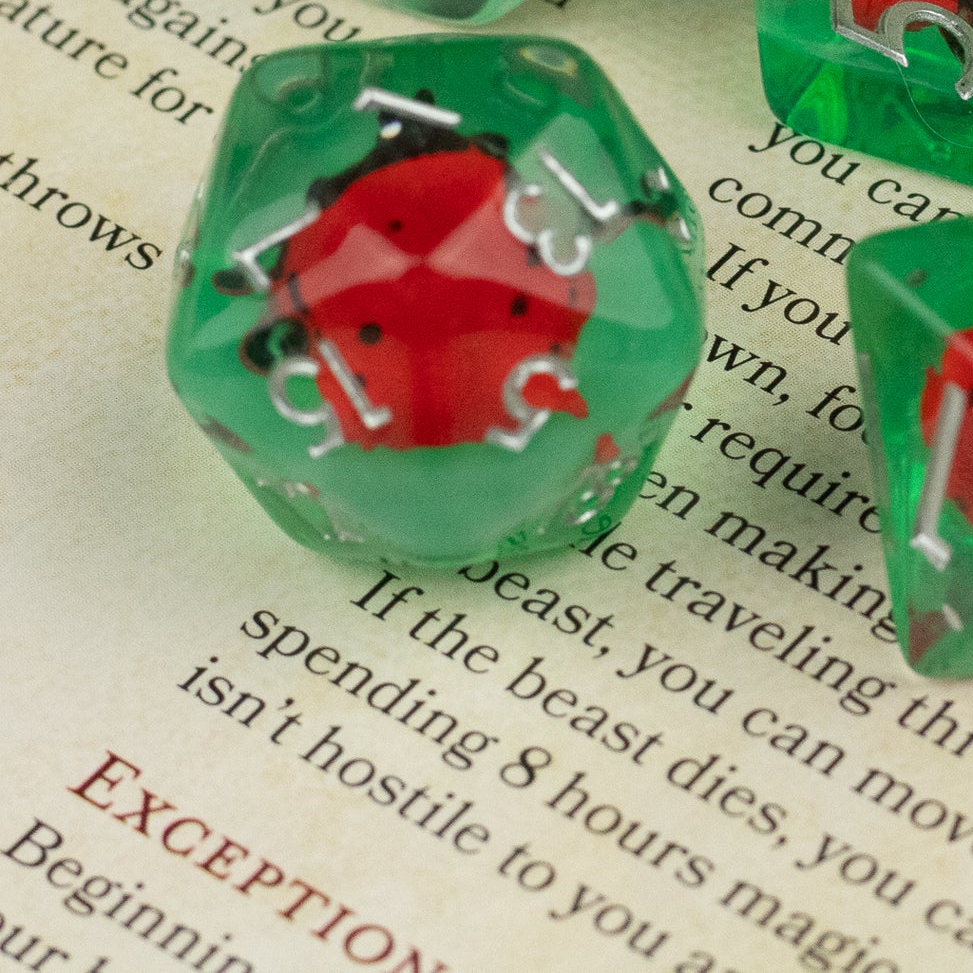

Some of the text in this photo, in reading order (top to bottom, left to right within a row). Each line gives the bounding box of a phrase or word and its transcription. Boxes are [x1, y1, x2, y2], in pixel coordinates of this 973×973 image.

[130, 67, 215, 126] for
[746, 125, 861, 187] you
[503, 150, 620, 276] 13
[706, 243, 770, 291] If
[740, 278, 850, 346] you
[644, 559, 898, 717] traveling
[239, 609, 716, 889] spending 8 hours
[350, 571, 425, 622] If
[408, 608, 501, 674] the
[504, 655, 663, 766] beast
[665, 753, 788, 848] dies,
[793, 832, 917, 909] you
[614, 642, 735, 716] you
[740, 707, 847, 778] can
[299, 724, 491, 854] hostile
[496, 843, 558, 893] to
[547, 882, 671, 961] you
